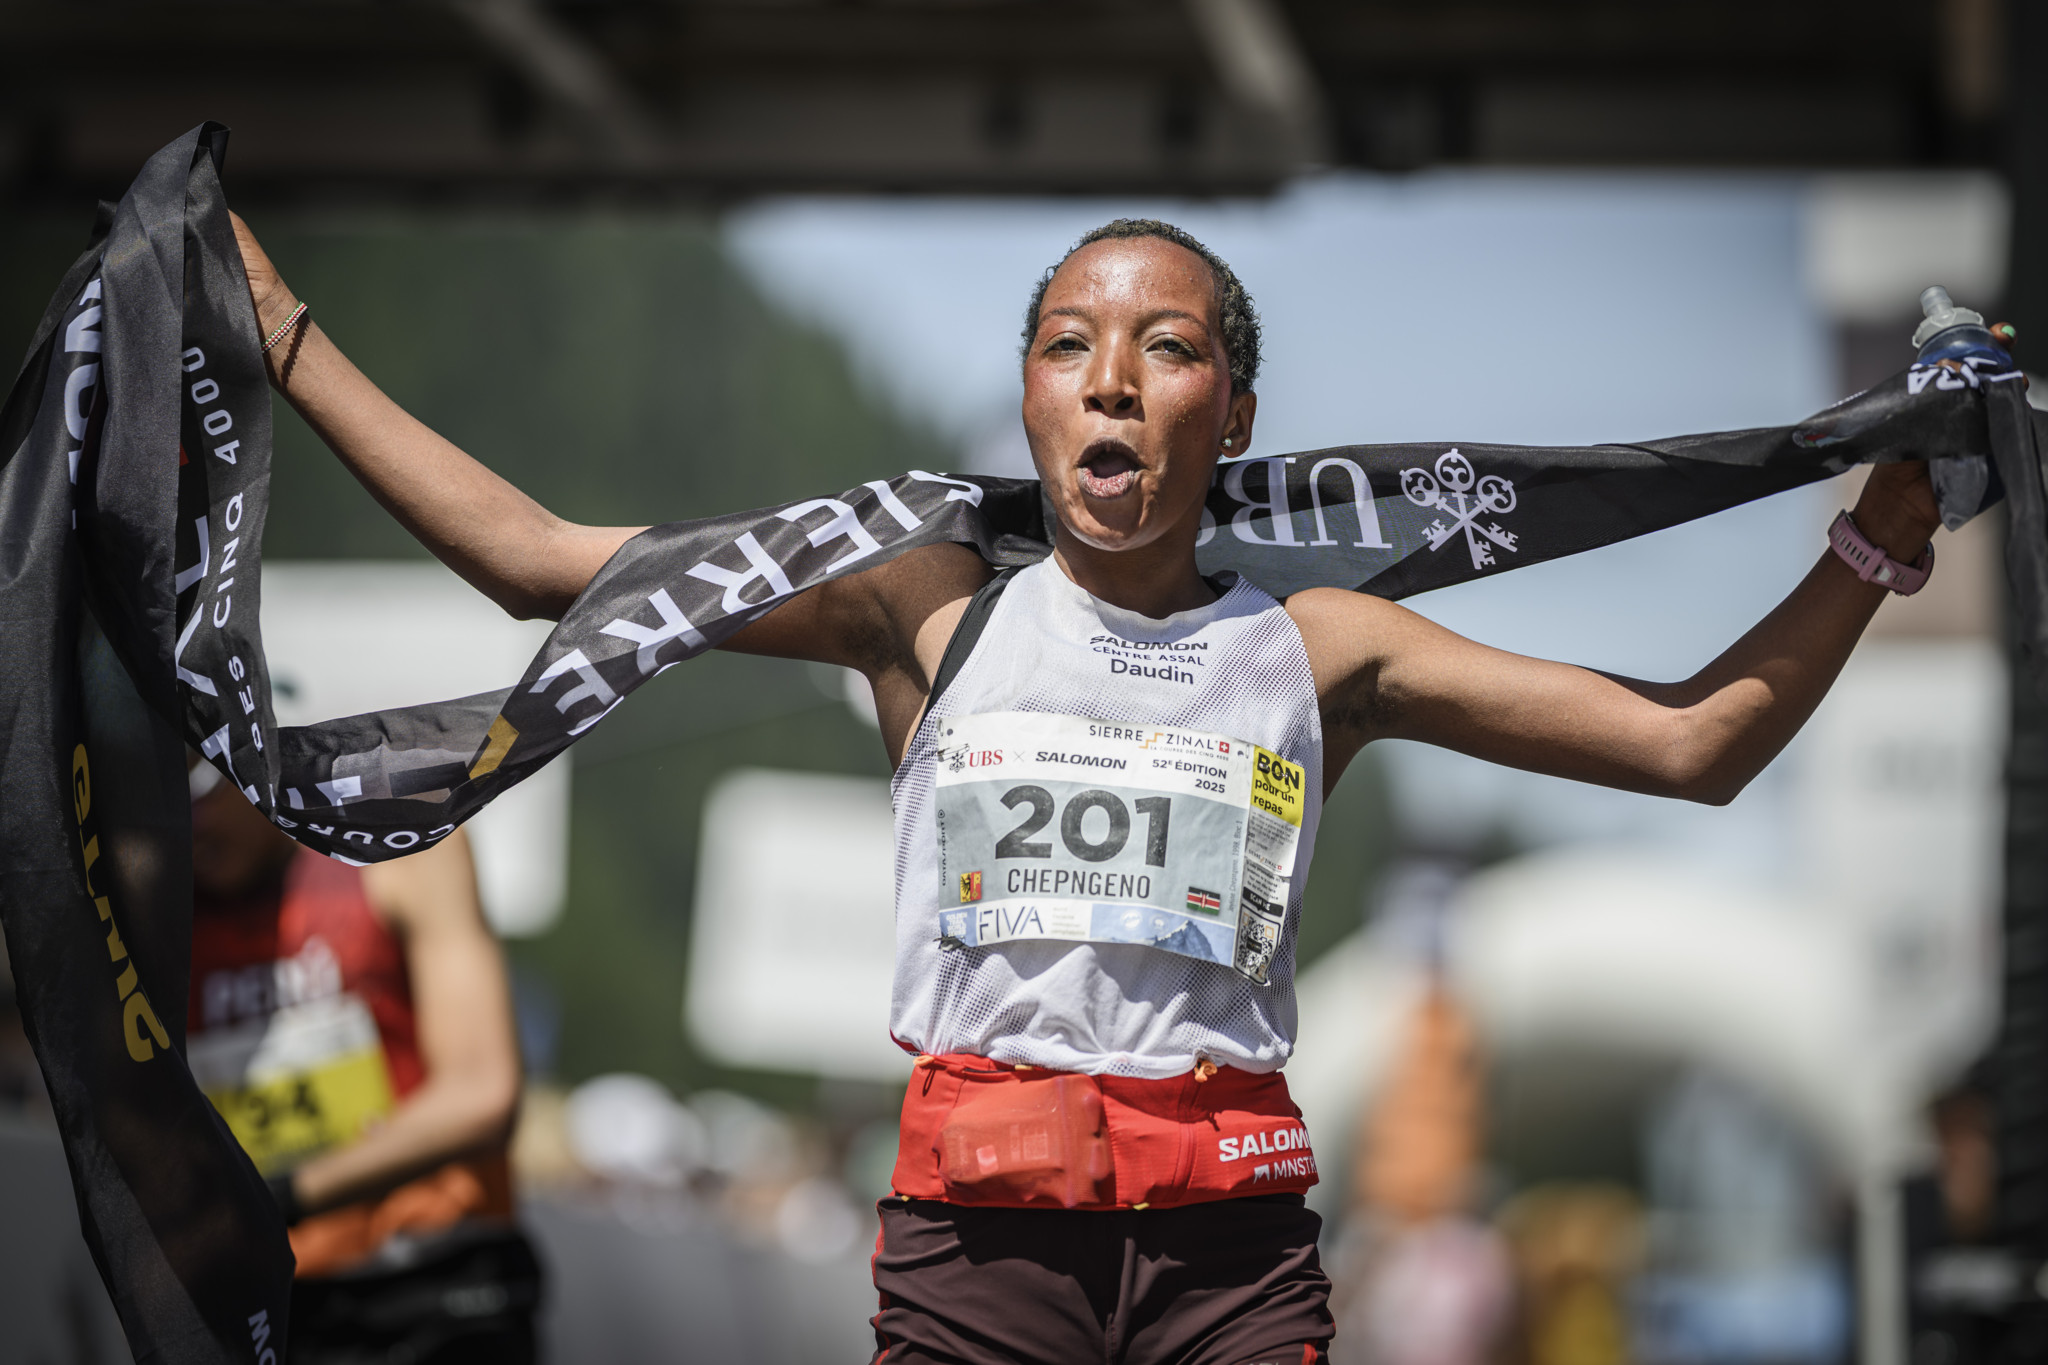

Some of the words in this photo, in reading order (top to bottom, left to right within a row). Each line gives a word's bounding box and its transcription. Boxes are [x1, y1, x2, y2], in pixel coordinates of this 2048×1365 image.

[181, 346, 240, 466] 4000
[1195, 457, 1393, 549] UB
[213, 491, 244, 629] CINQ
[1089, 635, 1208, 652] SALOMON
[1092, 646, 1152, 661] CENTRE
[1158, 654, 1205, 667] ASSAL
[1110, 658, 1194, 685] Daudin
[228, 655, 264, 752] DES
[1089, 725, 1144, 742] SIERRE
[1166, 733, 1214, 750] ZINAL
[968, 749, 1003, 768] UBS
[1035, 751, 1127, 770] SALOMON
[1174, 760, 1227, 780] ÉDITION
[1257, 752, 1300, 790] BON
[1195, 778, 1226, 794] 2025
[1254, 779, 1280, 797] pour
[1281, 791, 1295, 804] un
[1253, 795, 1283, 816] repas
[995, 784, 1172, 868] 201
[1007, 868, 1151, 899] CHEPNGENO
[979, 906, 1044, 941] FIVA
[1218, 1127, 1311, 1162] SALOM
